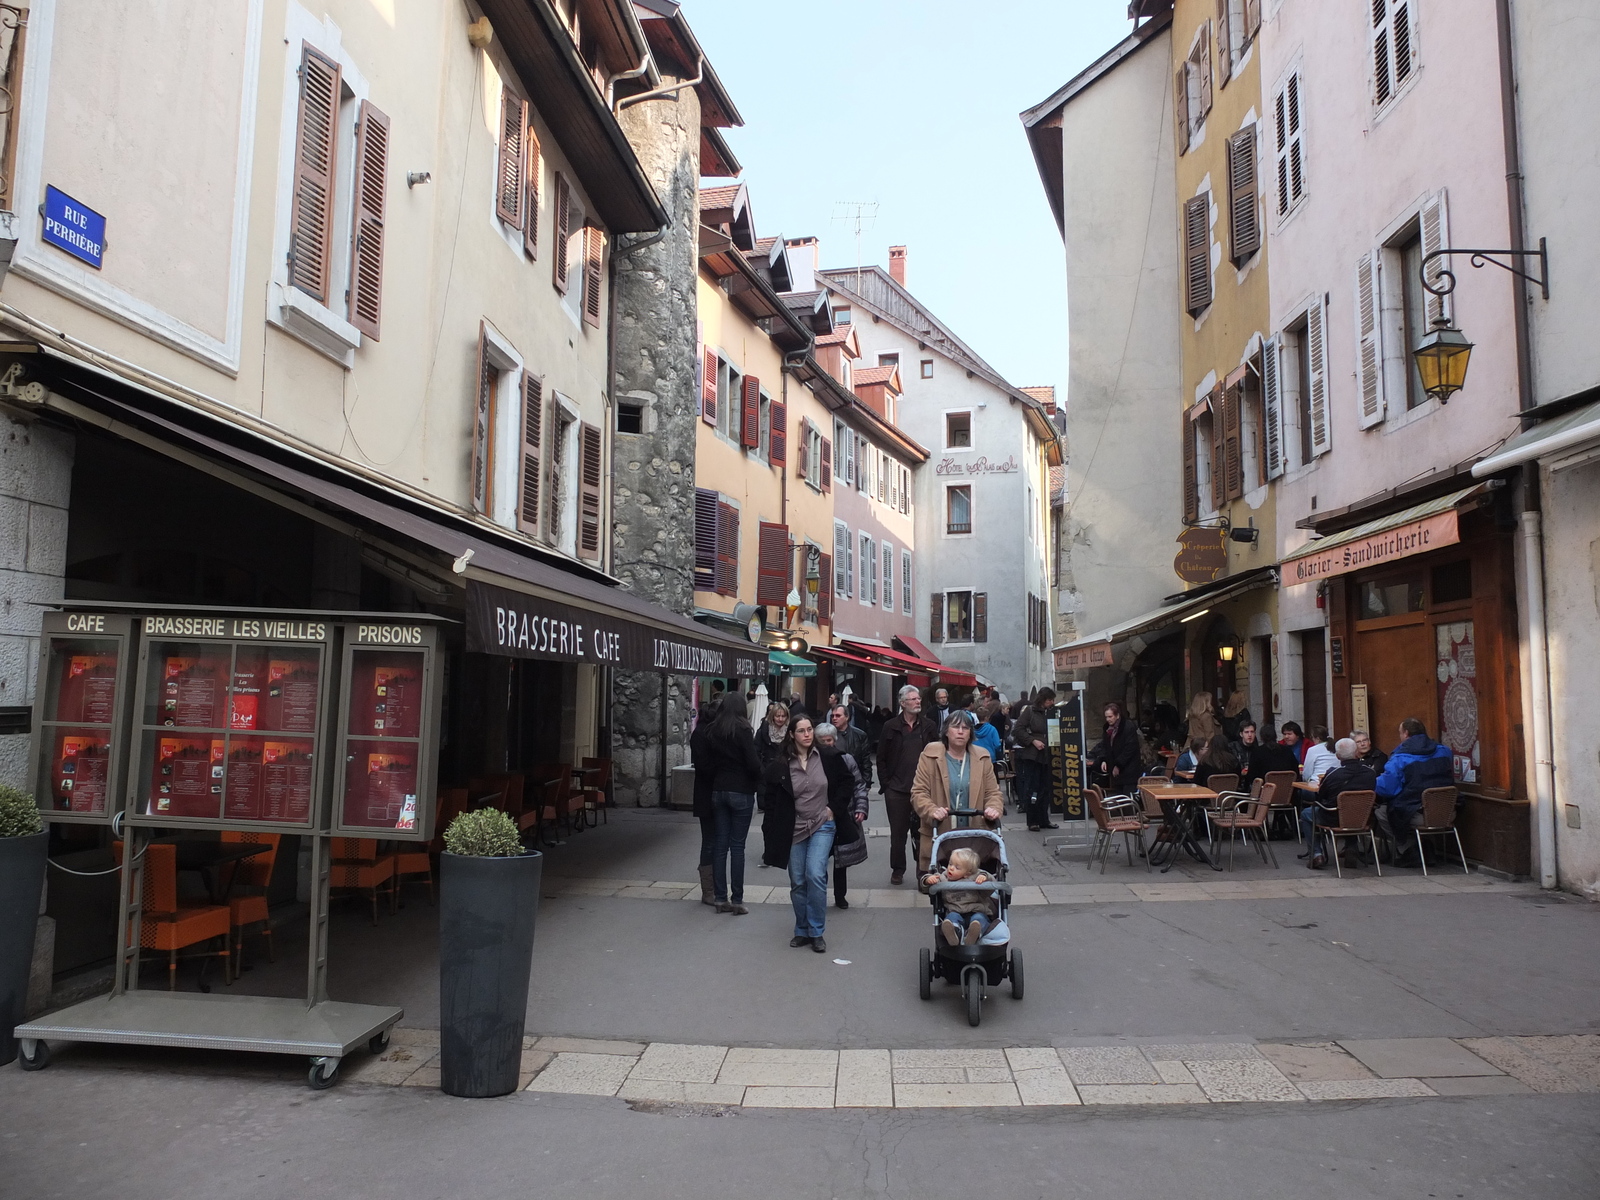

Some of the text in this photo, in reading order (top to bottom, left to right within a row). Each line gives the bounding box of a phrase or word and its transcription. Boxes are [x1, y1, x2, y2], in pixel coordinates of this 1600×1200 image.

[64, 204, 88, 230] RUE
[45, 216, 101, 258] PERRIÈRE
[1187, 541, 1220, 552] Crêperie
[1296, 557, 1332, 580] Glacier
[1343, 523, 1430, 568] Sandwicherie
[67, 614, 105, 632] CAFE
[145, 616, 326, 640] BRASSERIE LES VIEILLES
[358, 625, 422, 644] PRISONS
[496, 607, 620, 661] BRASSERIE CAFE
[654, 639, 723, 673] LES VIEILLES PRISONS
[1064, 743, 1082, 815] CRÊPERIE
